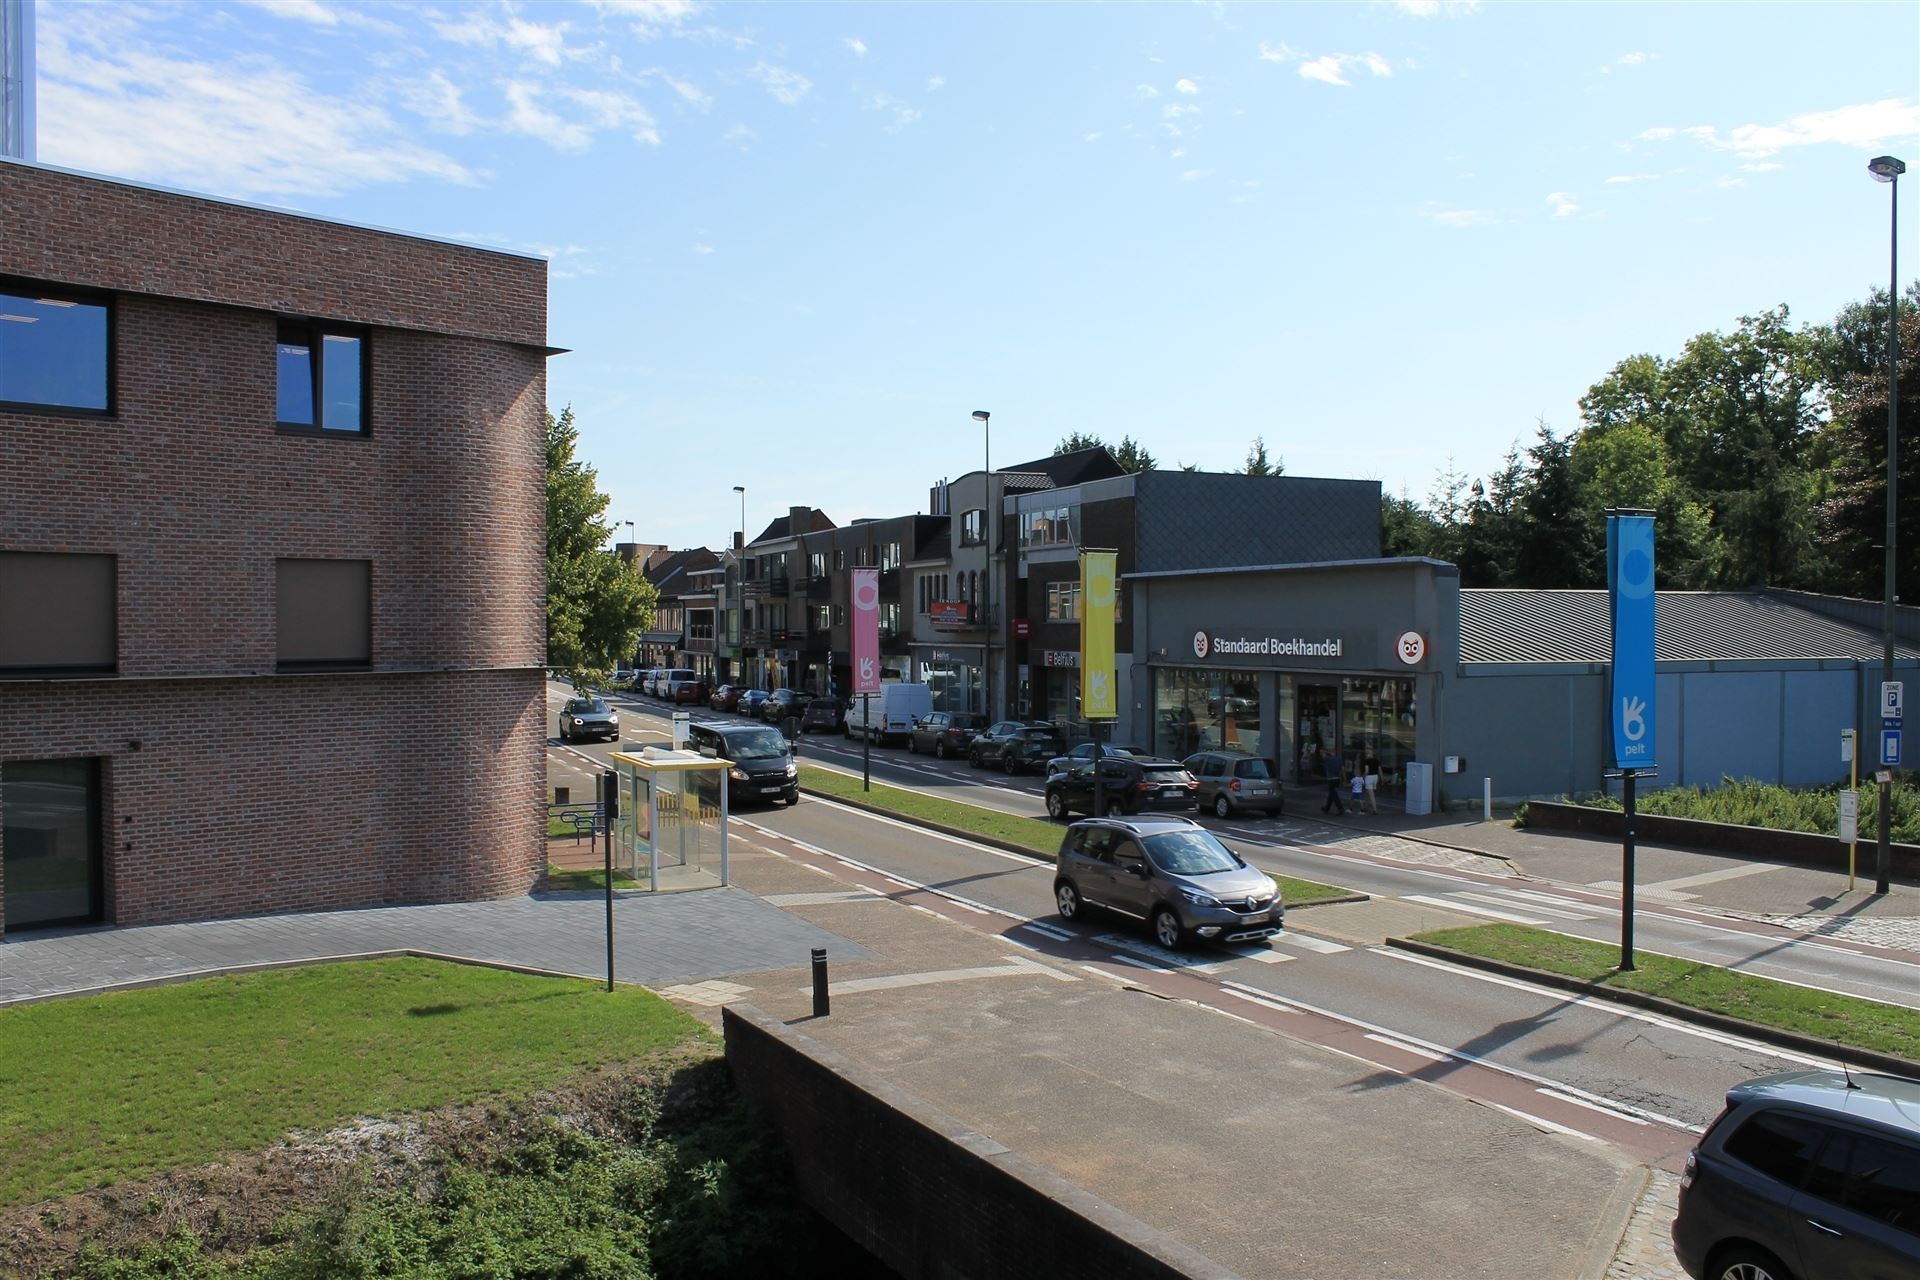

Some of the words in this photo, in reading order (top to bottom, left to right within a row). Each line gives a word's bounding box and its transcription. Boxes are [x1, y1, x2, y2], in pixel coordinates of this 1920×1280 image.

[1213, 638, 1269, 654] Standaard
[1270, 638, 1342, 656] Boekhandel
[1053, 652, 1073, 666] Belfius
[1625, 743, 1646, 756] pelt
